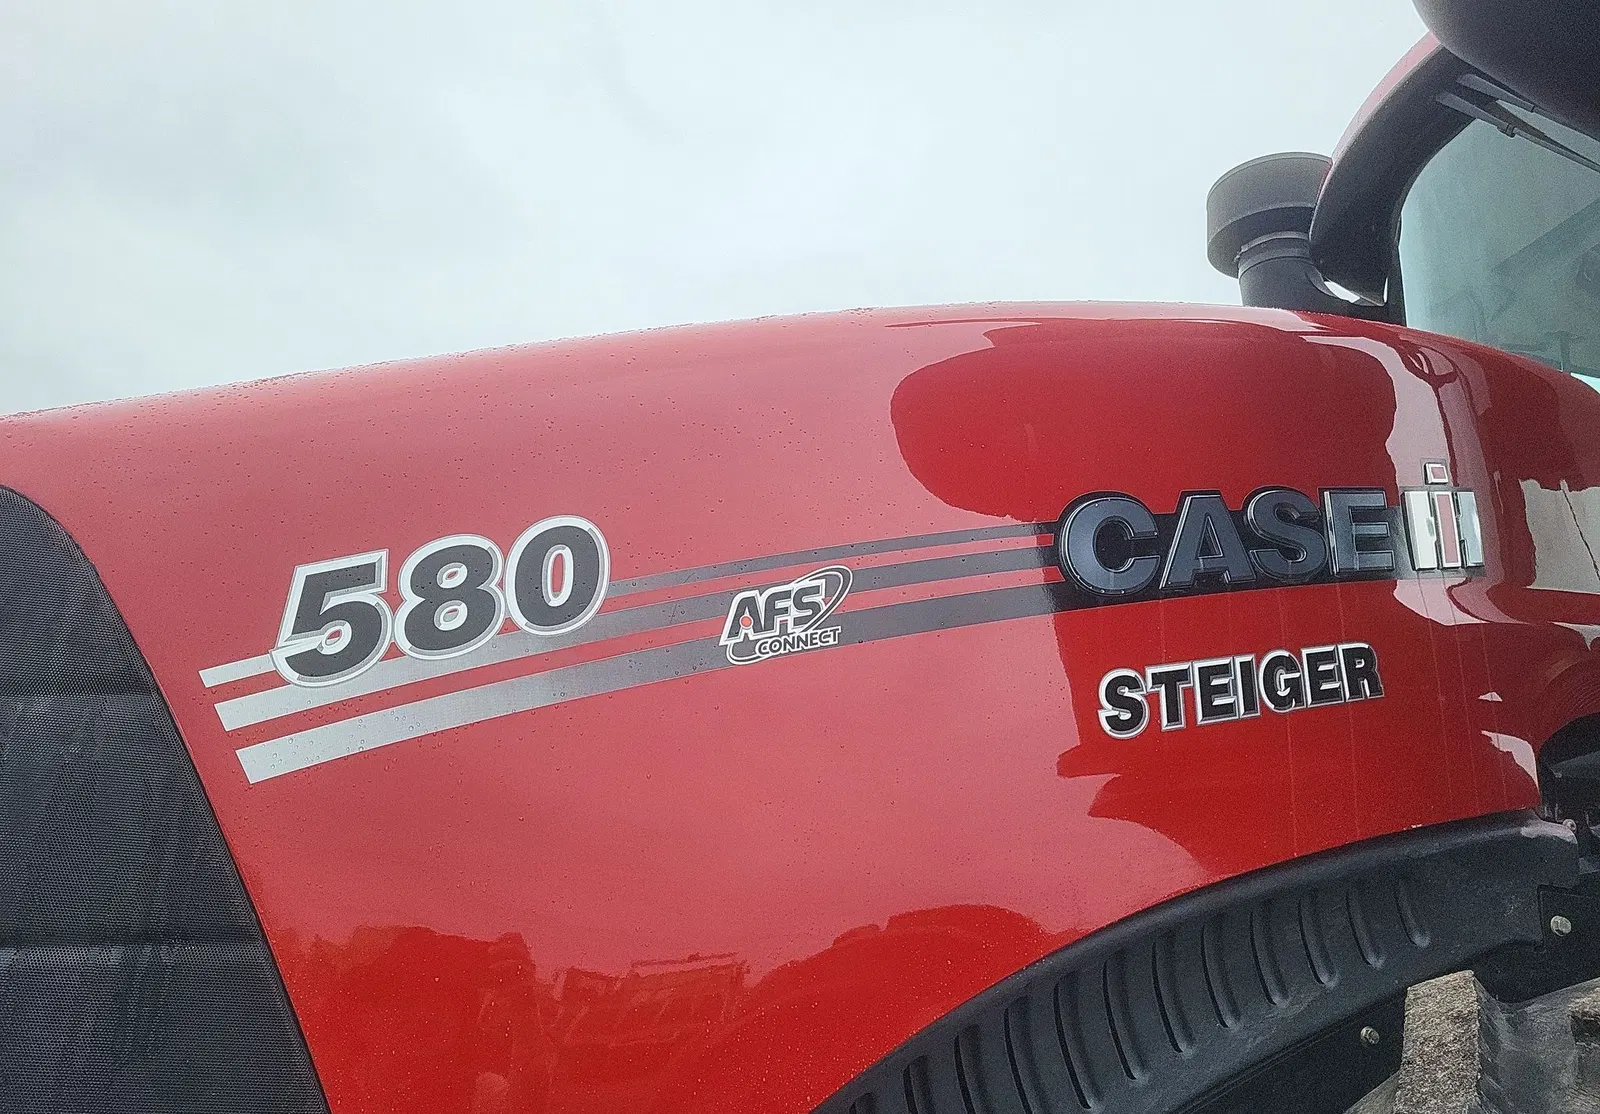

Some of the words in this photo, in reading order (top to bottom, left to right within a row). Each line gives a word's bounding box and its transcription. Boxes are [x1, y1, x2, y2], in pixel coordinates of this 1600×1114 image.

[1059, 489, 1396, 595] CASE
[271, 516, 610, 687] 580
[721, 580, 828, 645] AFS
[756, 626, 842, 656] CONNECT
[1098, 642, 1385, 739] STEIGER
